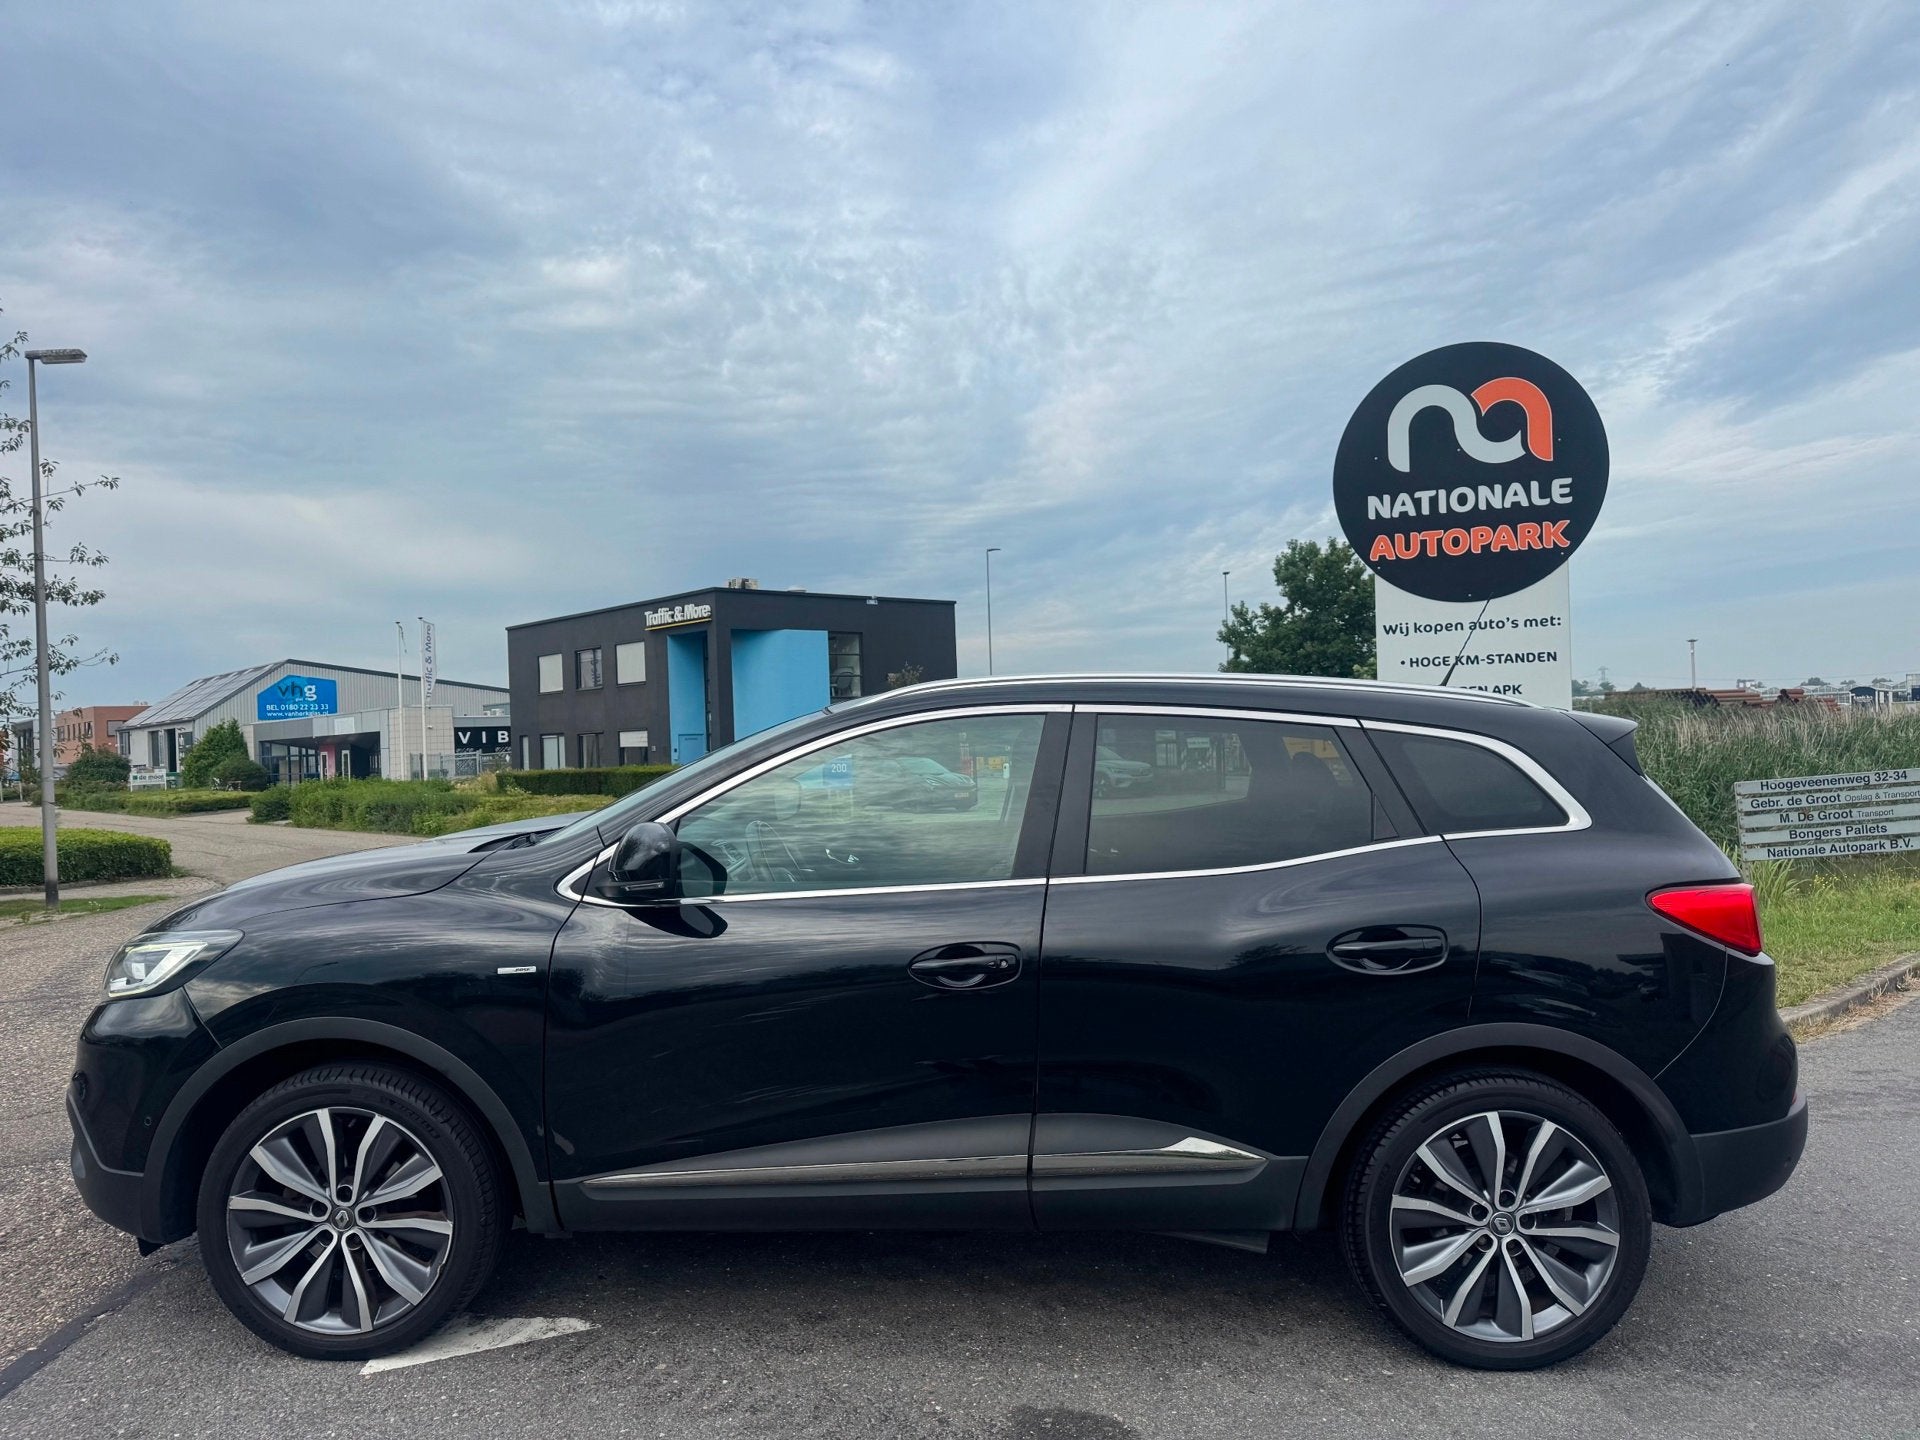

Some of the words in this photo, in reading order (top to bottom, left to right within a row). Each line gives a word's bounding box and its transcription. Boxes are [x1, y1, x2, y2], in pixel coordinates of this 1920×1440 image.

[1367, 477, 1573, 519] NATIONALE
[1370, 520, 1571, 561] AUTOPARK
[644, 607, 674, 627] Traffic
[674, 606, 683, 621] &
[684, 604, 711, 620] More
[1383, 622, 1409, 636] Wij
[1414, 621, 1464, 635] kopen
[1468, 617, 1519, 631] auto's
[1523, 615, 1562, 628] met:
[1409, 656, 1451, 668] HOGE
[1455, 651, 1558, 666] KM-STANDEN
[1492, 684, 1523, 695] APK
[1760, 774, 1871, 791] Hoogeveenenweg
[1874, 770, 1908, 782] 32-34
[1750, 797, 1784, 809] Gebr.
[1786, 796, 1803, 806] de
[1805, 793, 1842, 805] Groot
[1779, 813, 1794, 824] M.
[1798, 811, 1815, 822] De
[1817, 809, 1853, 821] Groot
[1857, 809, 1894, 818] Transport
[1789, 828, 1842, 840] Bongers
[1845, 824, 1888, 836] Pallets
[1767, 845, 1826, 858] Nationale
[1829, 840, 1887, 855] Autopark
[1889, 837, 1915, 849] B.V.
